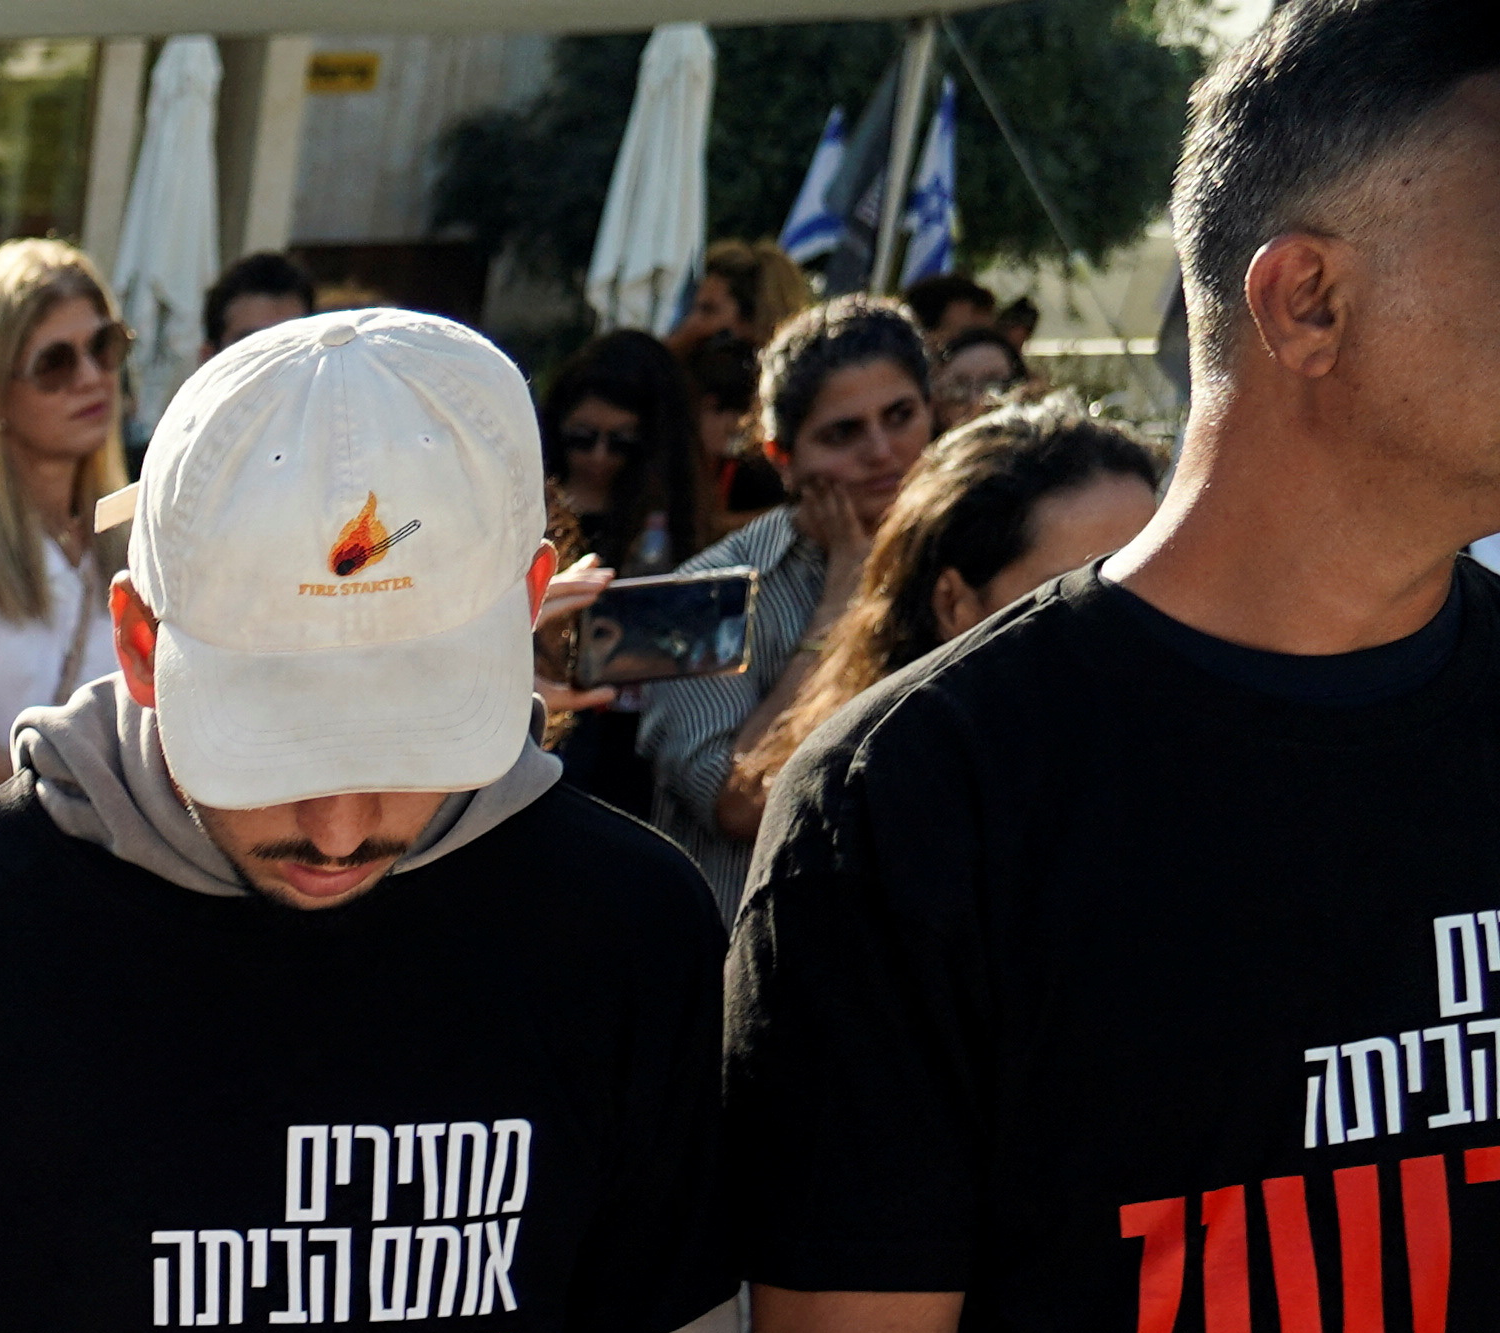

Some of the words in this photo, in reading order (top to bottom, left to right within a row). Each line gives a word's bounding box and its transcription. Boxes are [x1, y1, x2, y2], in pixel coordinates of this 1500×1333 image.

[298, 583, 338, 596] FIRE
[340, 576, 414, 596] STARTER
[1304, 1017, 1500, 1149] הביתה
[285, 1117, 533, 1223] מחזירים
[151, 1228, 351, 1328] הביתה
[370, 1216, 522, 1322] אותם
